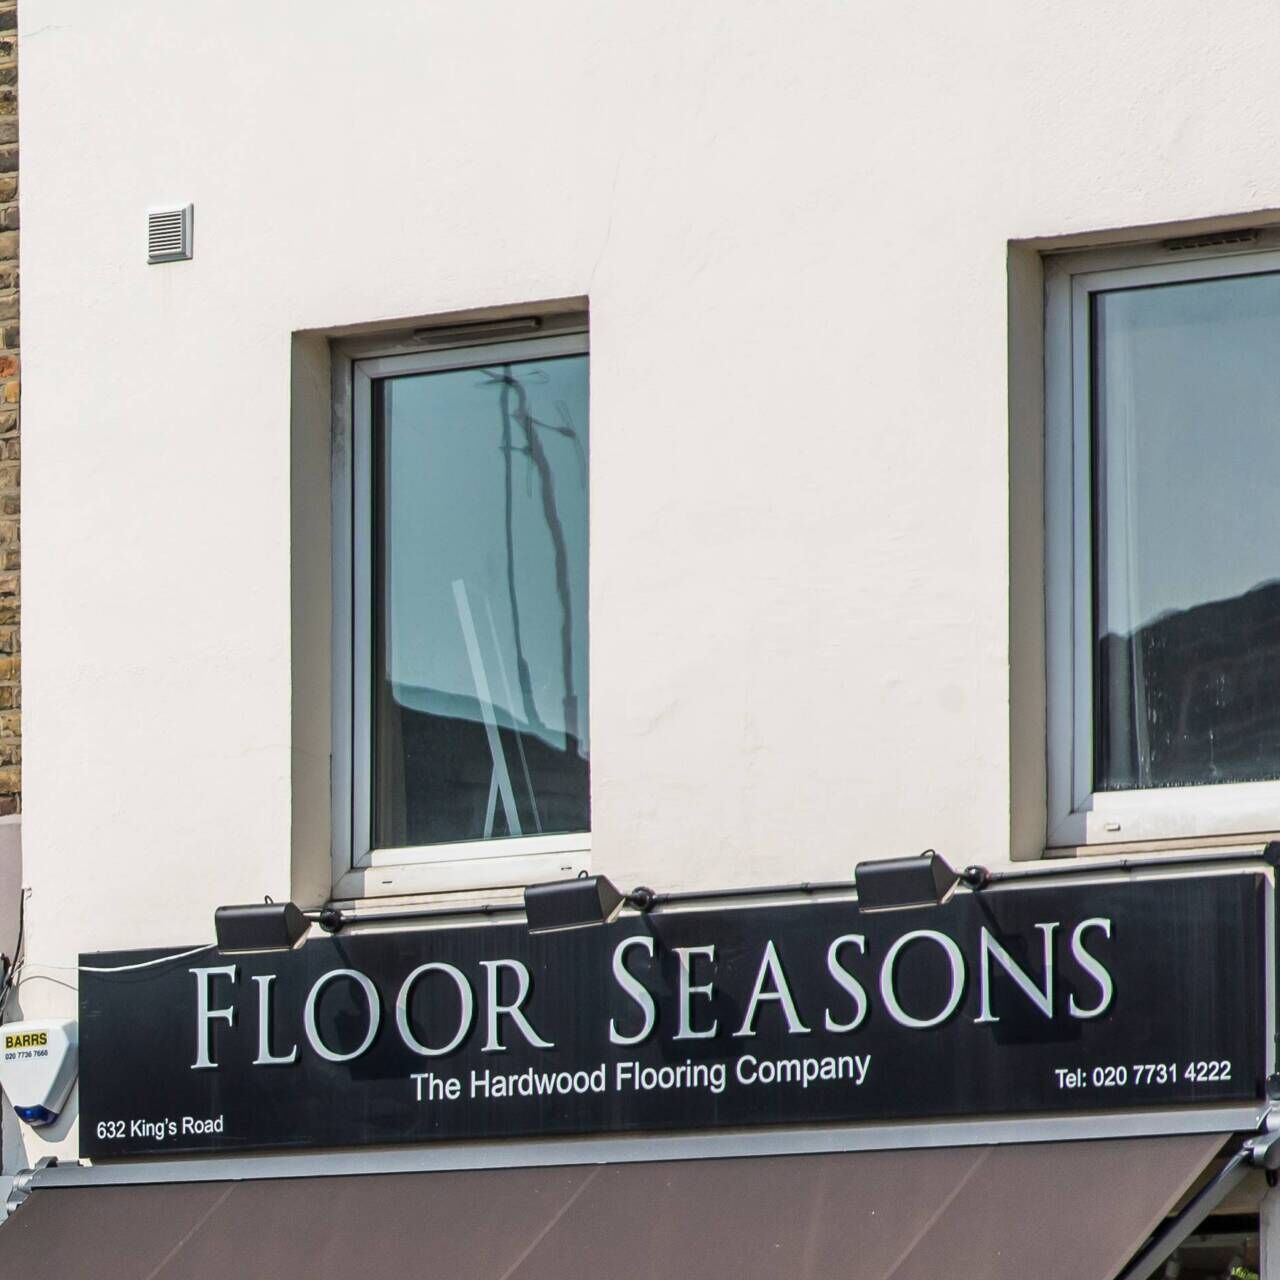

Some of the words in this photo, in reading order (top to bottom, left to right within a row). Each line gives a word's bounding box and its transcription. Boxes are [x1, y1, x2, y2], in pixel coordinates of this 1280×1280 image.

[189, 959, 555, 1069] FLOOR
[609, 917, 1113, 1046] SEASONS
[5, 1032, 48, 1049] BARRS
[5, 1052, 16, 1061] 020
[411, 1073, 461, 1101] The
[470, 1065, 606, 1098] Hardwood
[616, 1059, 726, 1093] Flooring
[736, 1054, 871, 1088] Company
[1055, 1067, 1087, 1089] Tel:
[1093, 1066, 1128, 1087] 020
[1133, 1063, 1177, 1085] 7731
[1184, 1060, 1232, 1082] 4222
[97, 1121, 126, 1139] 632
[130, 1117, 177, 1140] King's
[182, 1114, 224, 1135] Road
